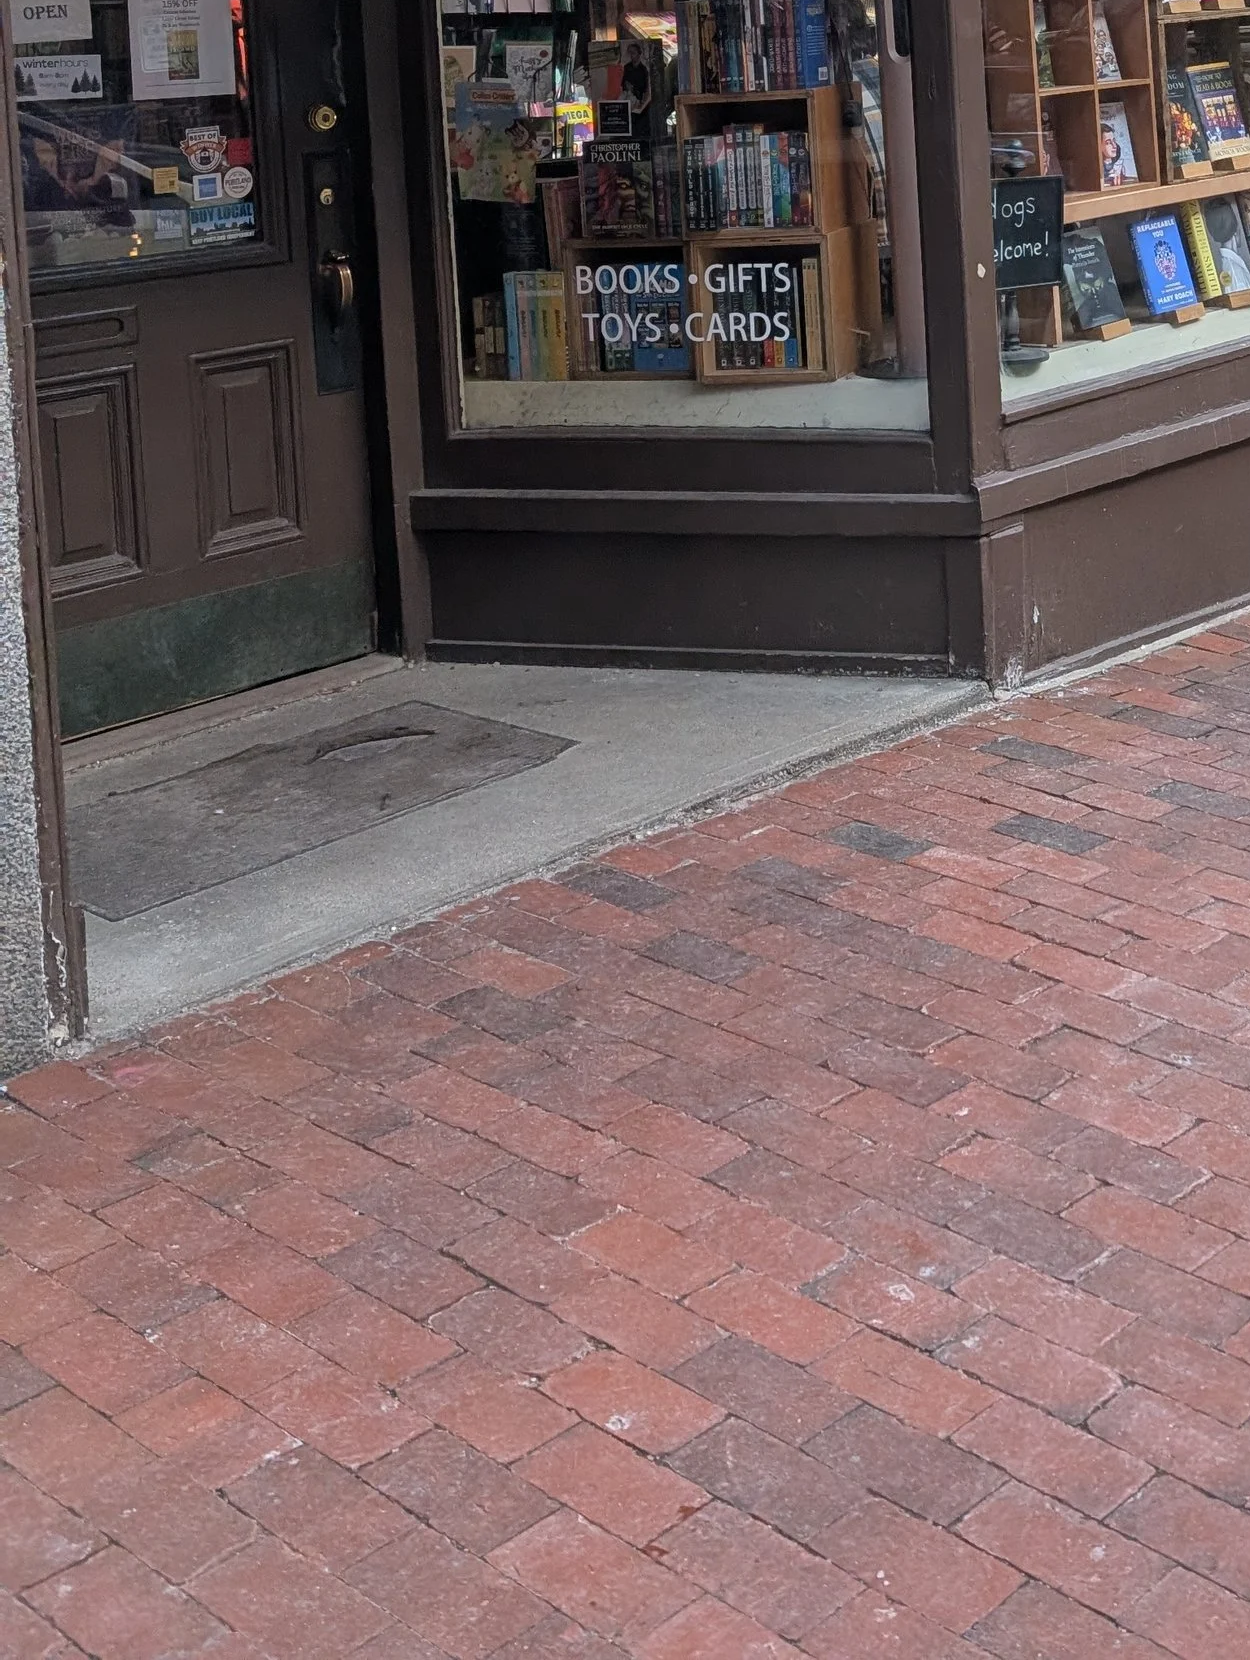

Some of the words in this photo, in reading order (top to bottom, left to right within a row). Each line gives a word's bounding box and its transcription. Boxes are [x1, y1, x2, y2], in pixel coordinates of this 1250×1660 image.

[162, 0, 180, 8] 15%
[182, 0, 198, 7] OFF
[23, 4, 68, 20] OPEN
[590, 143, 641, 152] CHRISTOPHER
[591, 151, 641, 163] PAOLINI
[191, 208, 214, 224] BUY
[217, 204, 253, 220] LOCAL
[1137, 218, 1175, 233] REPLACEABLE
[1152, 230, 1164, 238] YOU
[993, 230, 1049, 263] elcome!
[575, 264, 680, 295] BOOKS
[704, 262, 791, 294] GIFTS
[1157, 295, 1174, 305] MARY
[1174, 290, 1194, 301] ROACH
[581, 312, 660, 343] TOYS
[685, 312, 790, 343] CARDS
